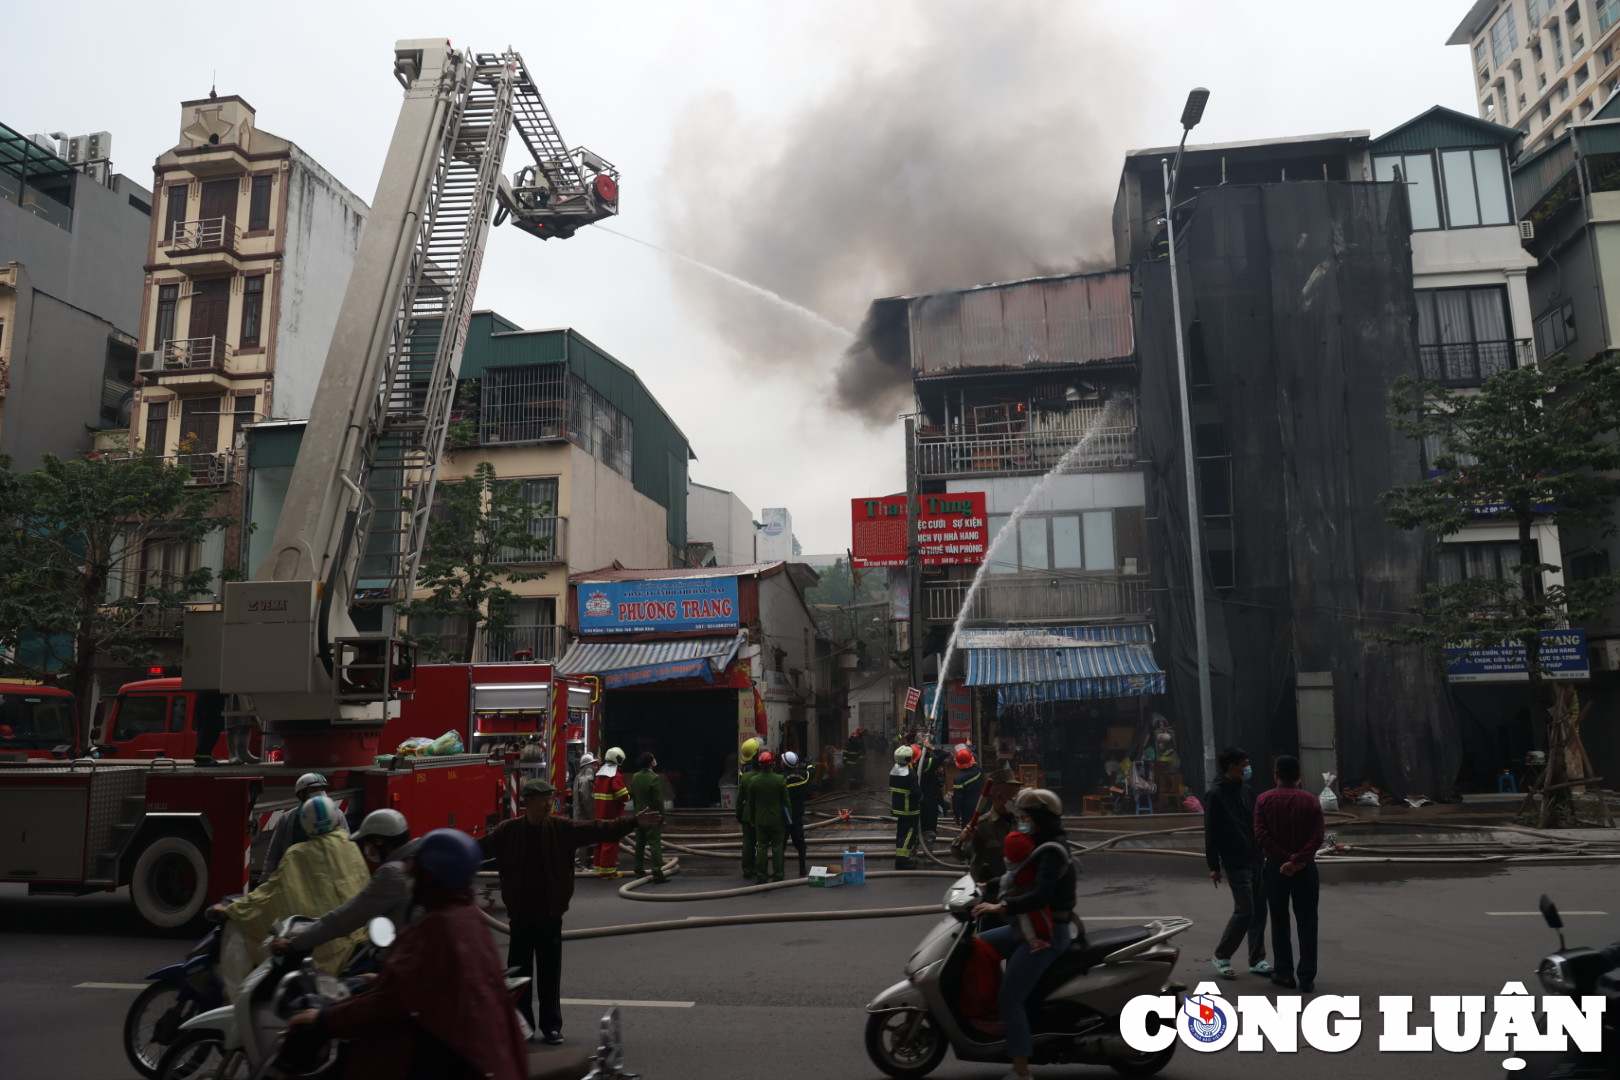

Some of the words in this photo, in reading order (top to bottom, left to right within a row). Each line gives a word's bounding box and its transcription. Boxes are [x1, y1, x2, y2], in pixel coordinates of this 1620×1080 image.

[926, 498, 973, 517] Tùng
[952, 519, 963, 529] SỰ
[964, 517, 983, 529] KIỆN
[933, 533, 942, 543] VỤ
[943, 531, 958, 541] NHÀ
[945, 543, 958, 554] VĂN
[959, 542, 983, 553] PHÒNG
[618, 600, 677, 621] PHƯƠNG
[681, 598, 732, 619] TRANG
